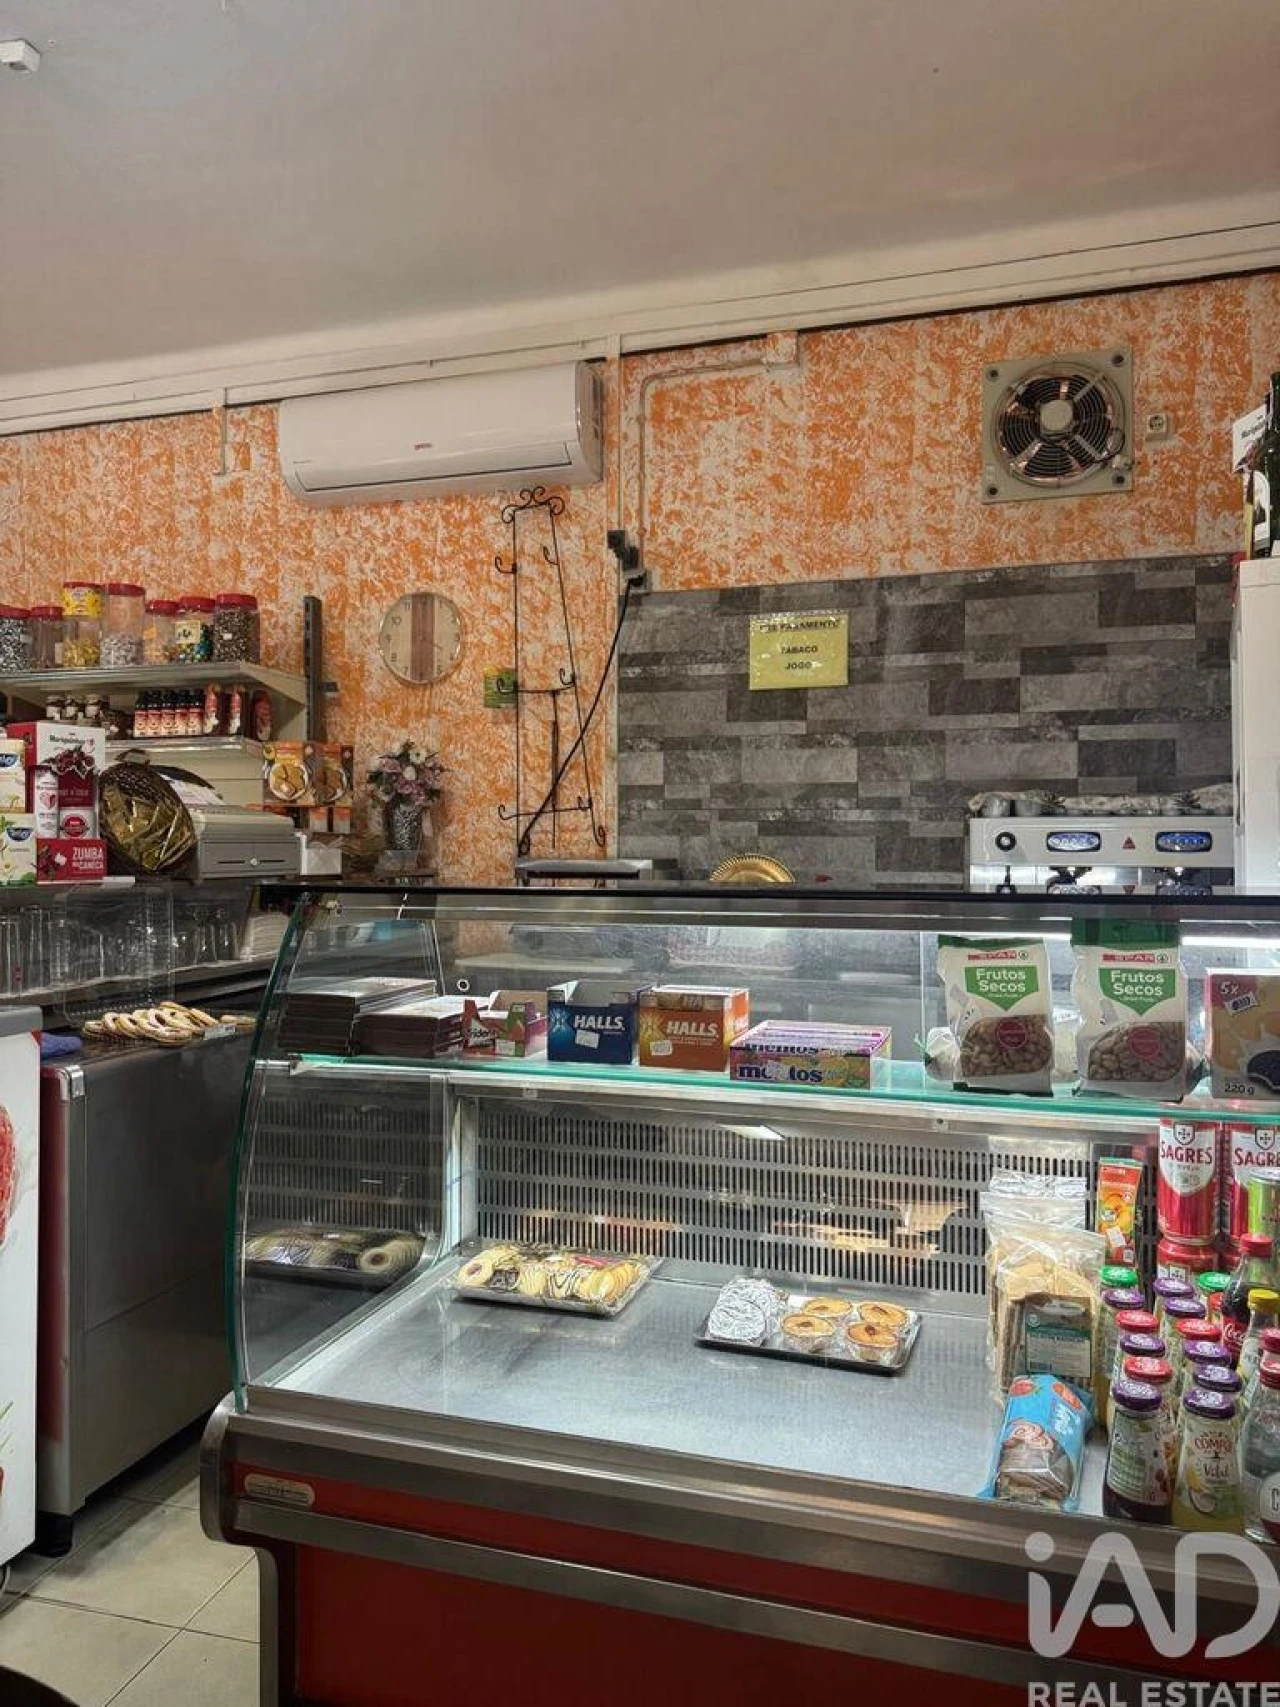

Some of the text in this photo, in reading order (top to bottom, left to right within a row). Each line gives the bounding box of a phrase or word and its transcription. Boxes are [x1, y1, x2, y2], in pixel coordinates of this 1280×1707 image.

[781, 644, 818, 654] TABACO
[785, 662, 812, 670] JOGO
[73, 846, 104, 861] ZUMBA
[976, 968, 1026, 981] Frutos
[1110, 970, 1164, 983] Frutos
[978, 980, 1026, 992] Secos
[1113, 983, 1163, 996] Secos
[1221, 981, 1239, 995] 5x
[573, 1014, 625, 1029] HALLS
[666, 1021, 718, 1036] HALLS
[1161, 1142, 1213, 1165] SAGRES
